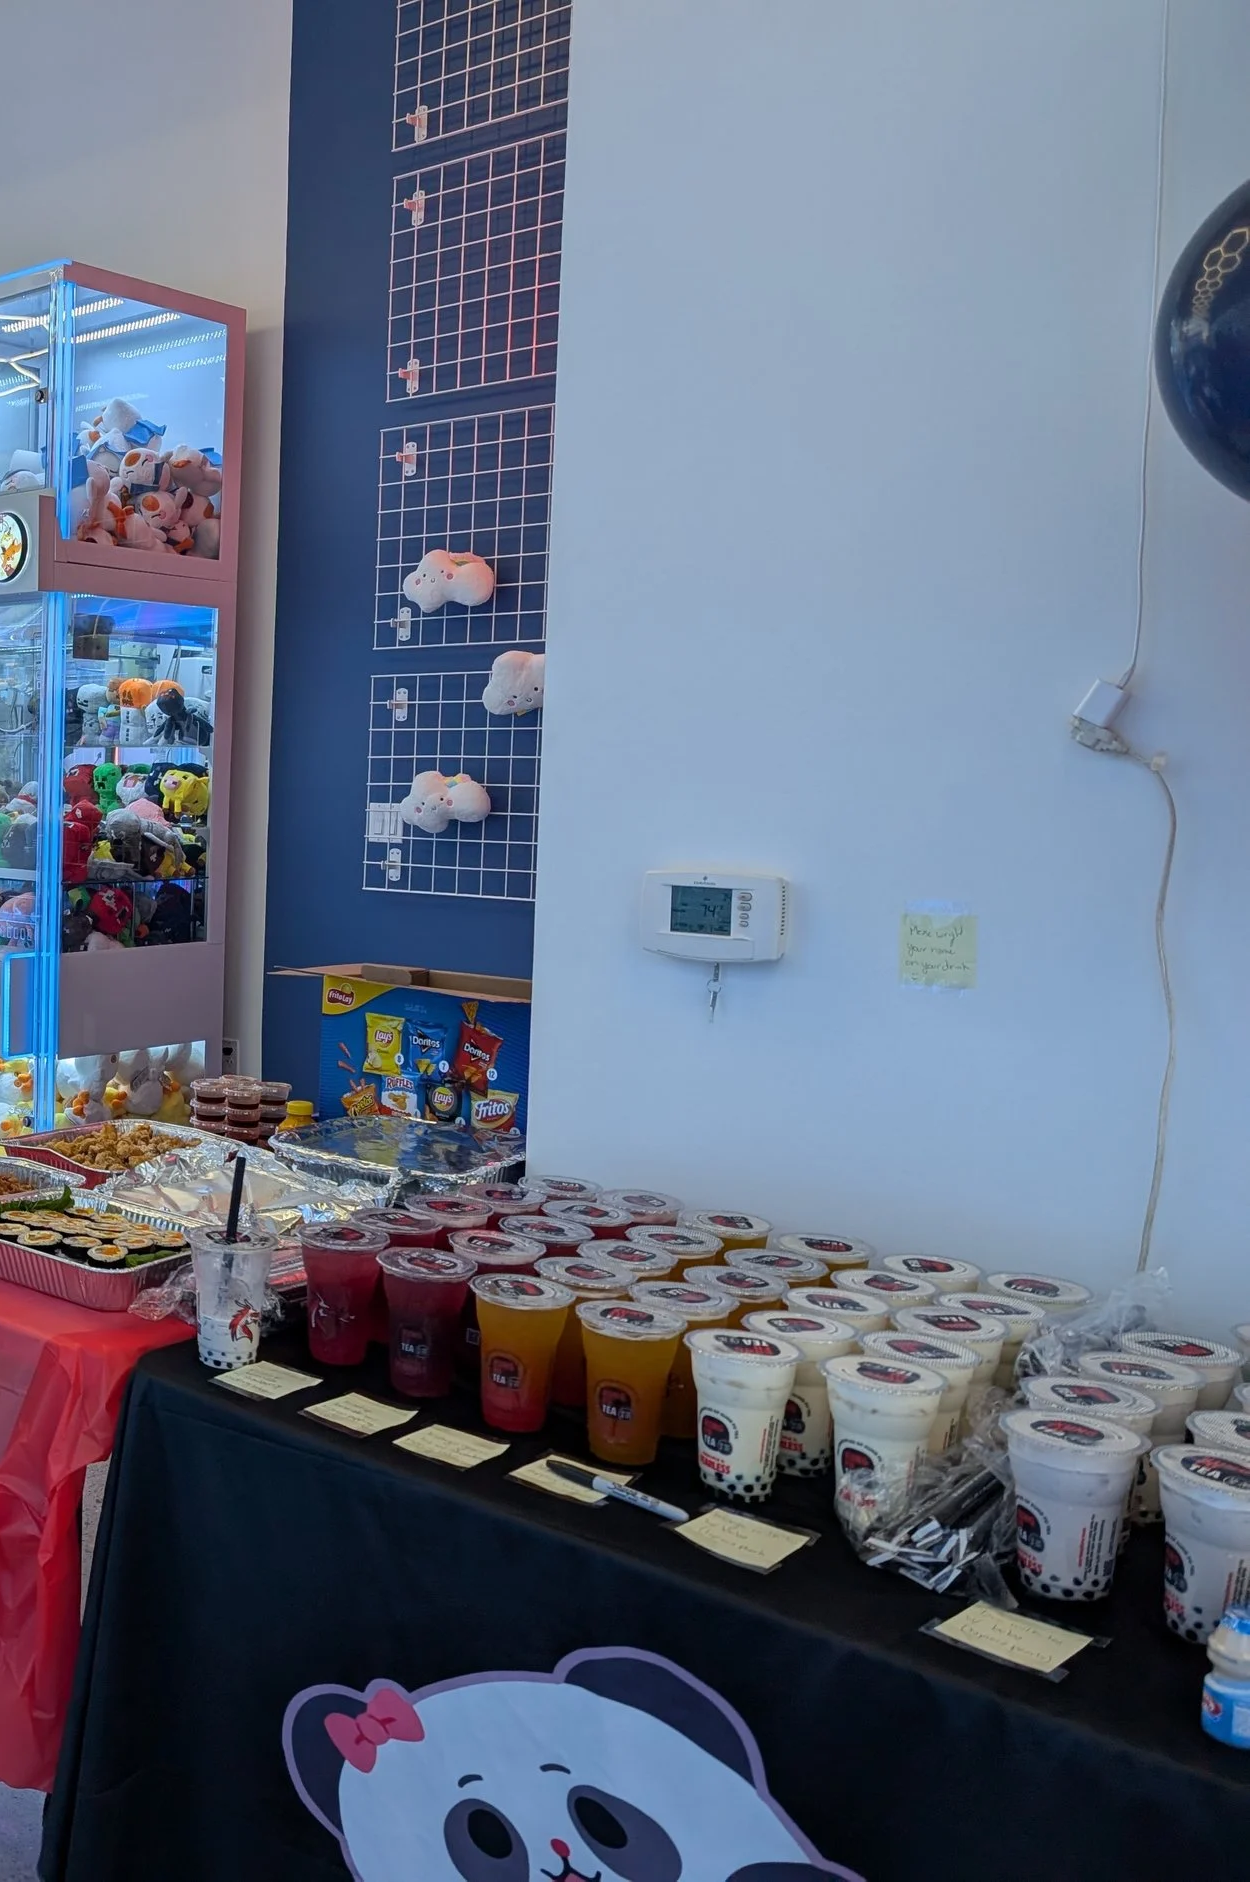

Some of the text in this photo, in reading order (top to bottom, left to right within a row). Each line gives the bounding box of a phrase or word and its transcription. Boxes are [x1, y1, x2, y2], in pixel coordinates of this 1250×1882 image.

[412, 1035, 440, 1048] Doritos
[464, 1043, 490, 1061] Doritos
[475, 1100, 510, 1120] Fritos
[400, 1343, 415, 1353] TEA
[493, 1373, 506, 1384] TEA
[602, 1404, 617, 1416] TEA
[1189, 1463, 1221, 1479] TEA
